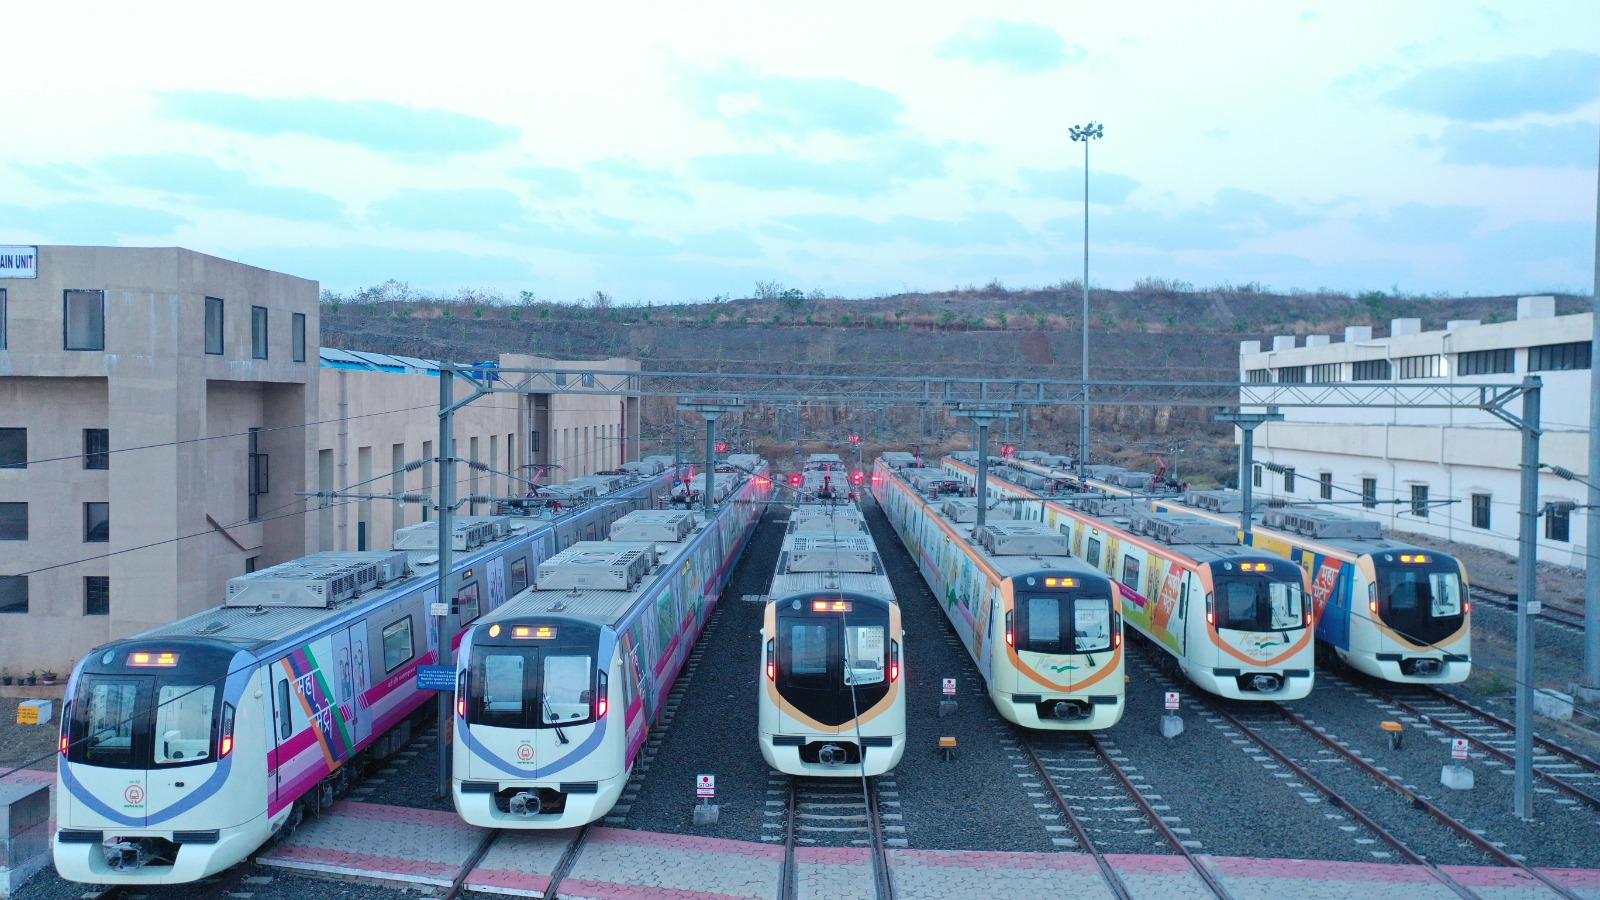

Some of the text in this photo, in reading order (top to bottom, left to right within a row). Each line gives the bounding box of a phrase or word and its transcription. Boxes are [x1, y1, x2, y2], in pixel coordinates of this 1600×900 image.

[15, 255, 33, 269] UNIT
[1320, 564, 1339, 587] महा
[292, 668, 321, 702] महा
[308, 697, 337, 740] मेट्रो
